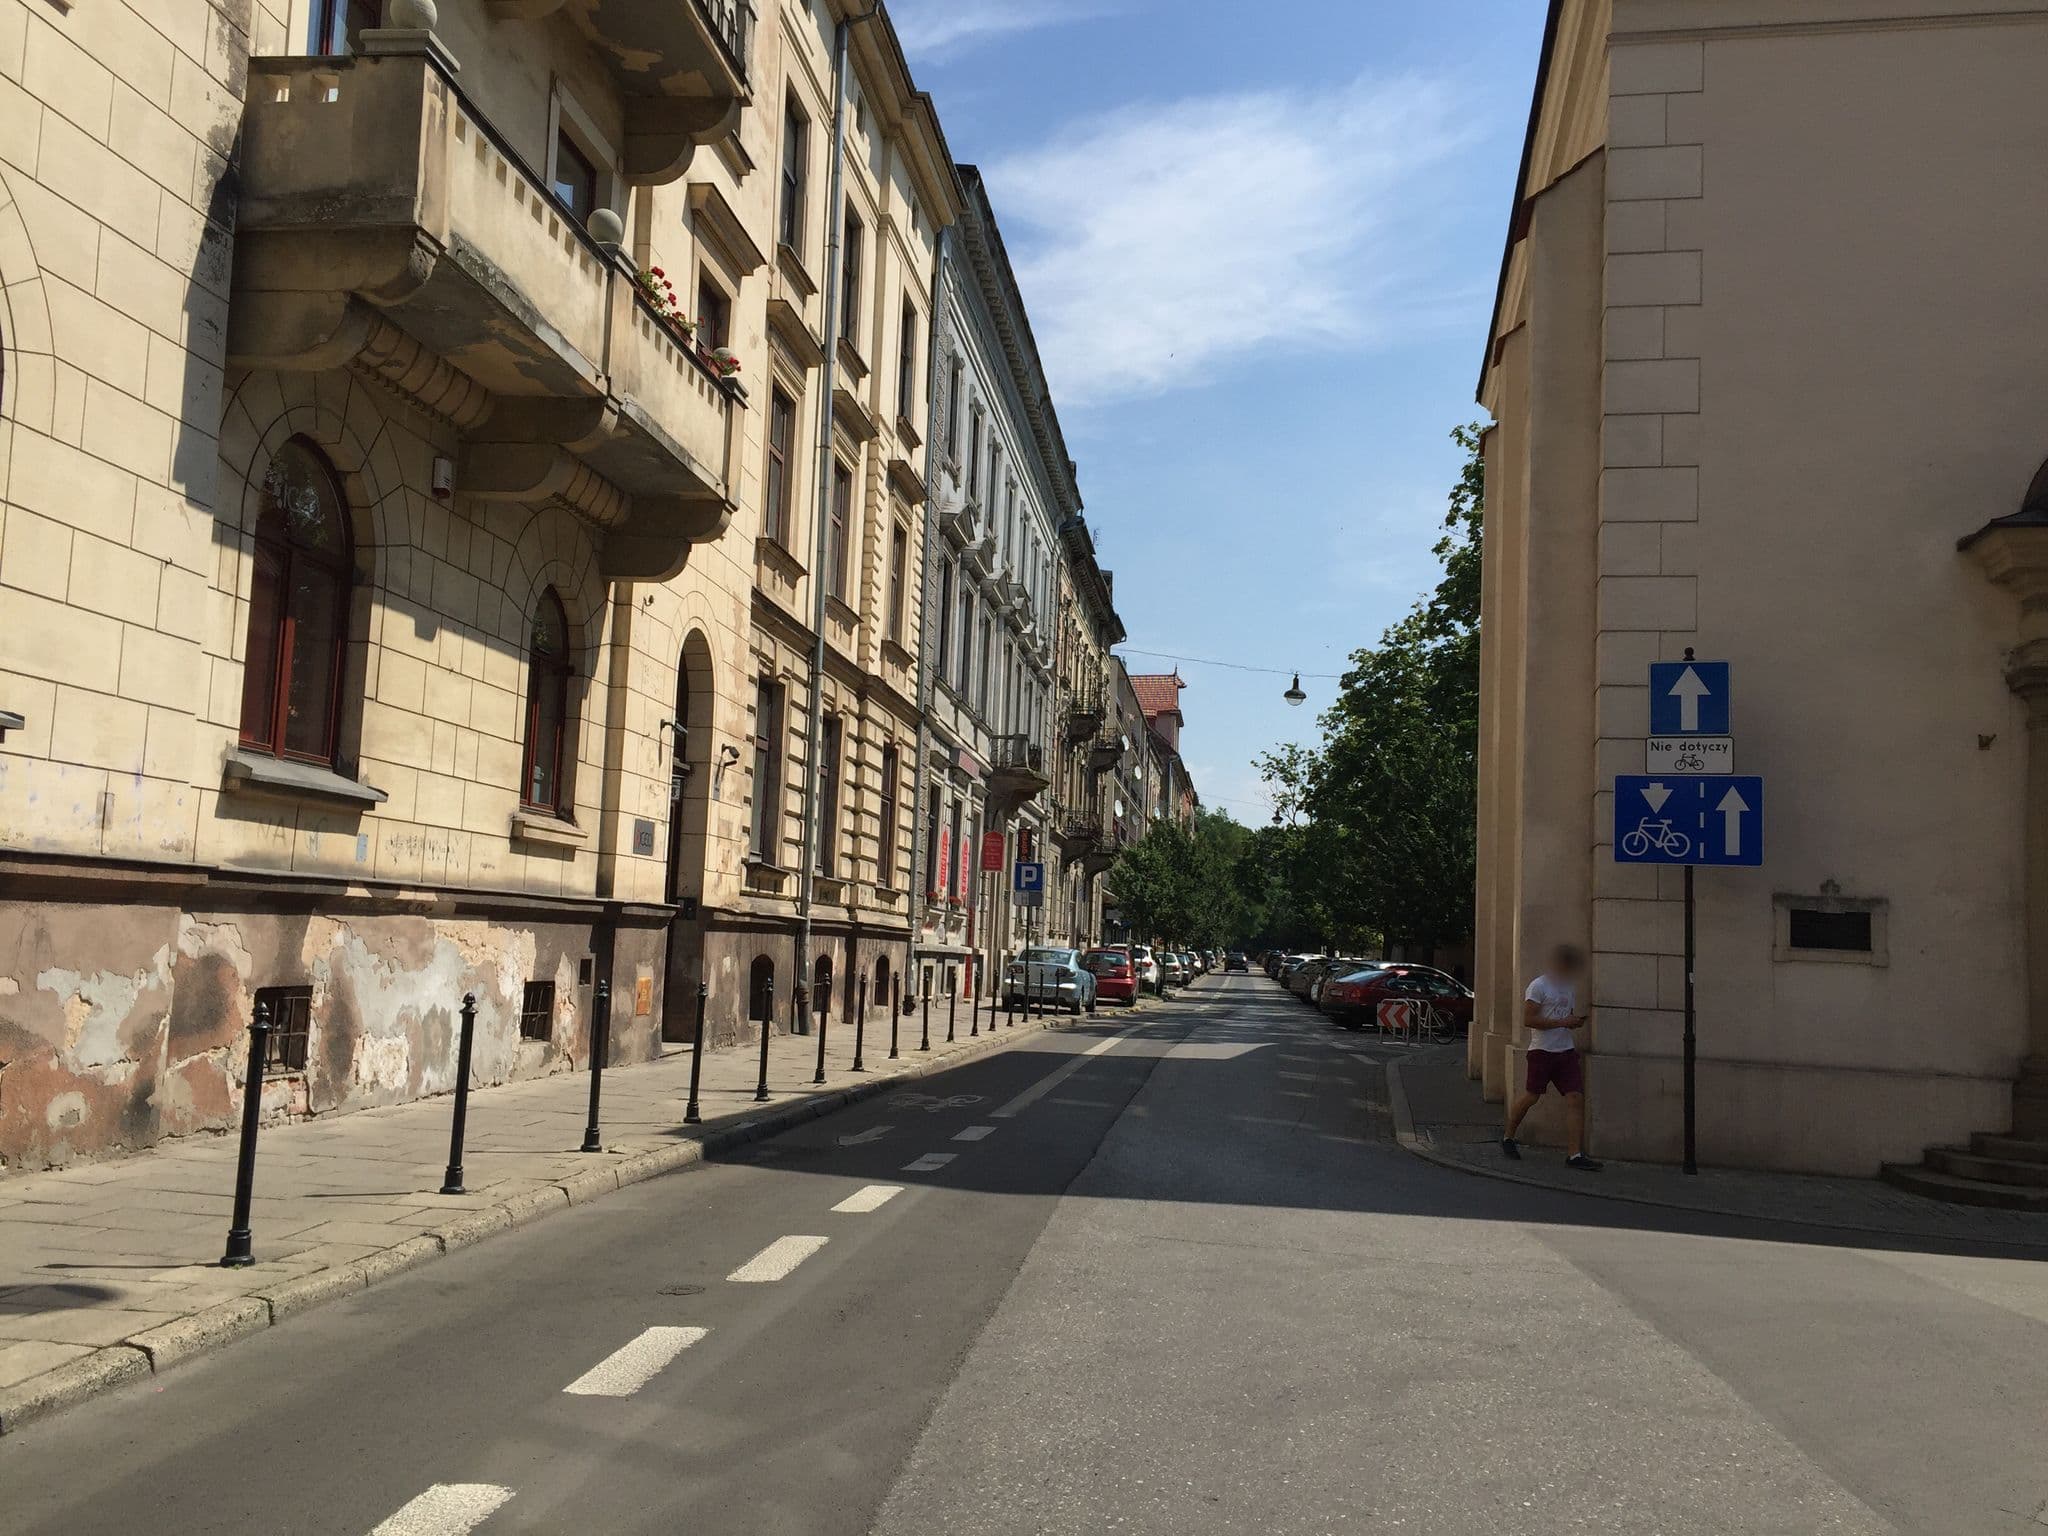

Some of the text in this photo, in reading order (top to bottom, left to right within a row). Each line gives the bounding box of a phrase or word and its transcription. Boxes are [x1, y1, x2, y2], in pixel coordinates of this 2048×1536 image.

[1650, 741, 1728, 754] Nie dotyczy
[1020, 865, 1038, 888] P
